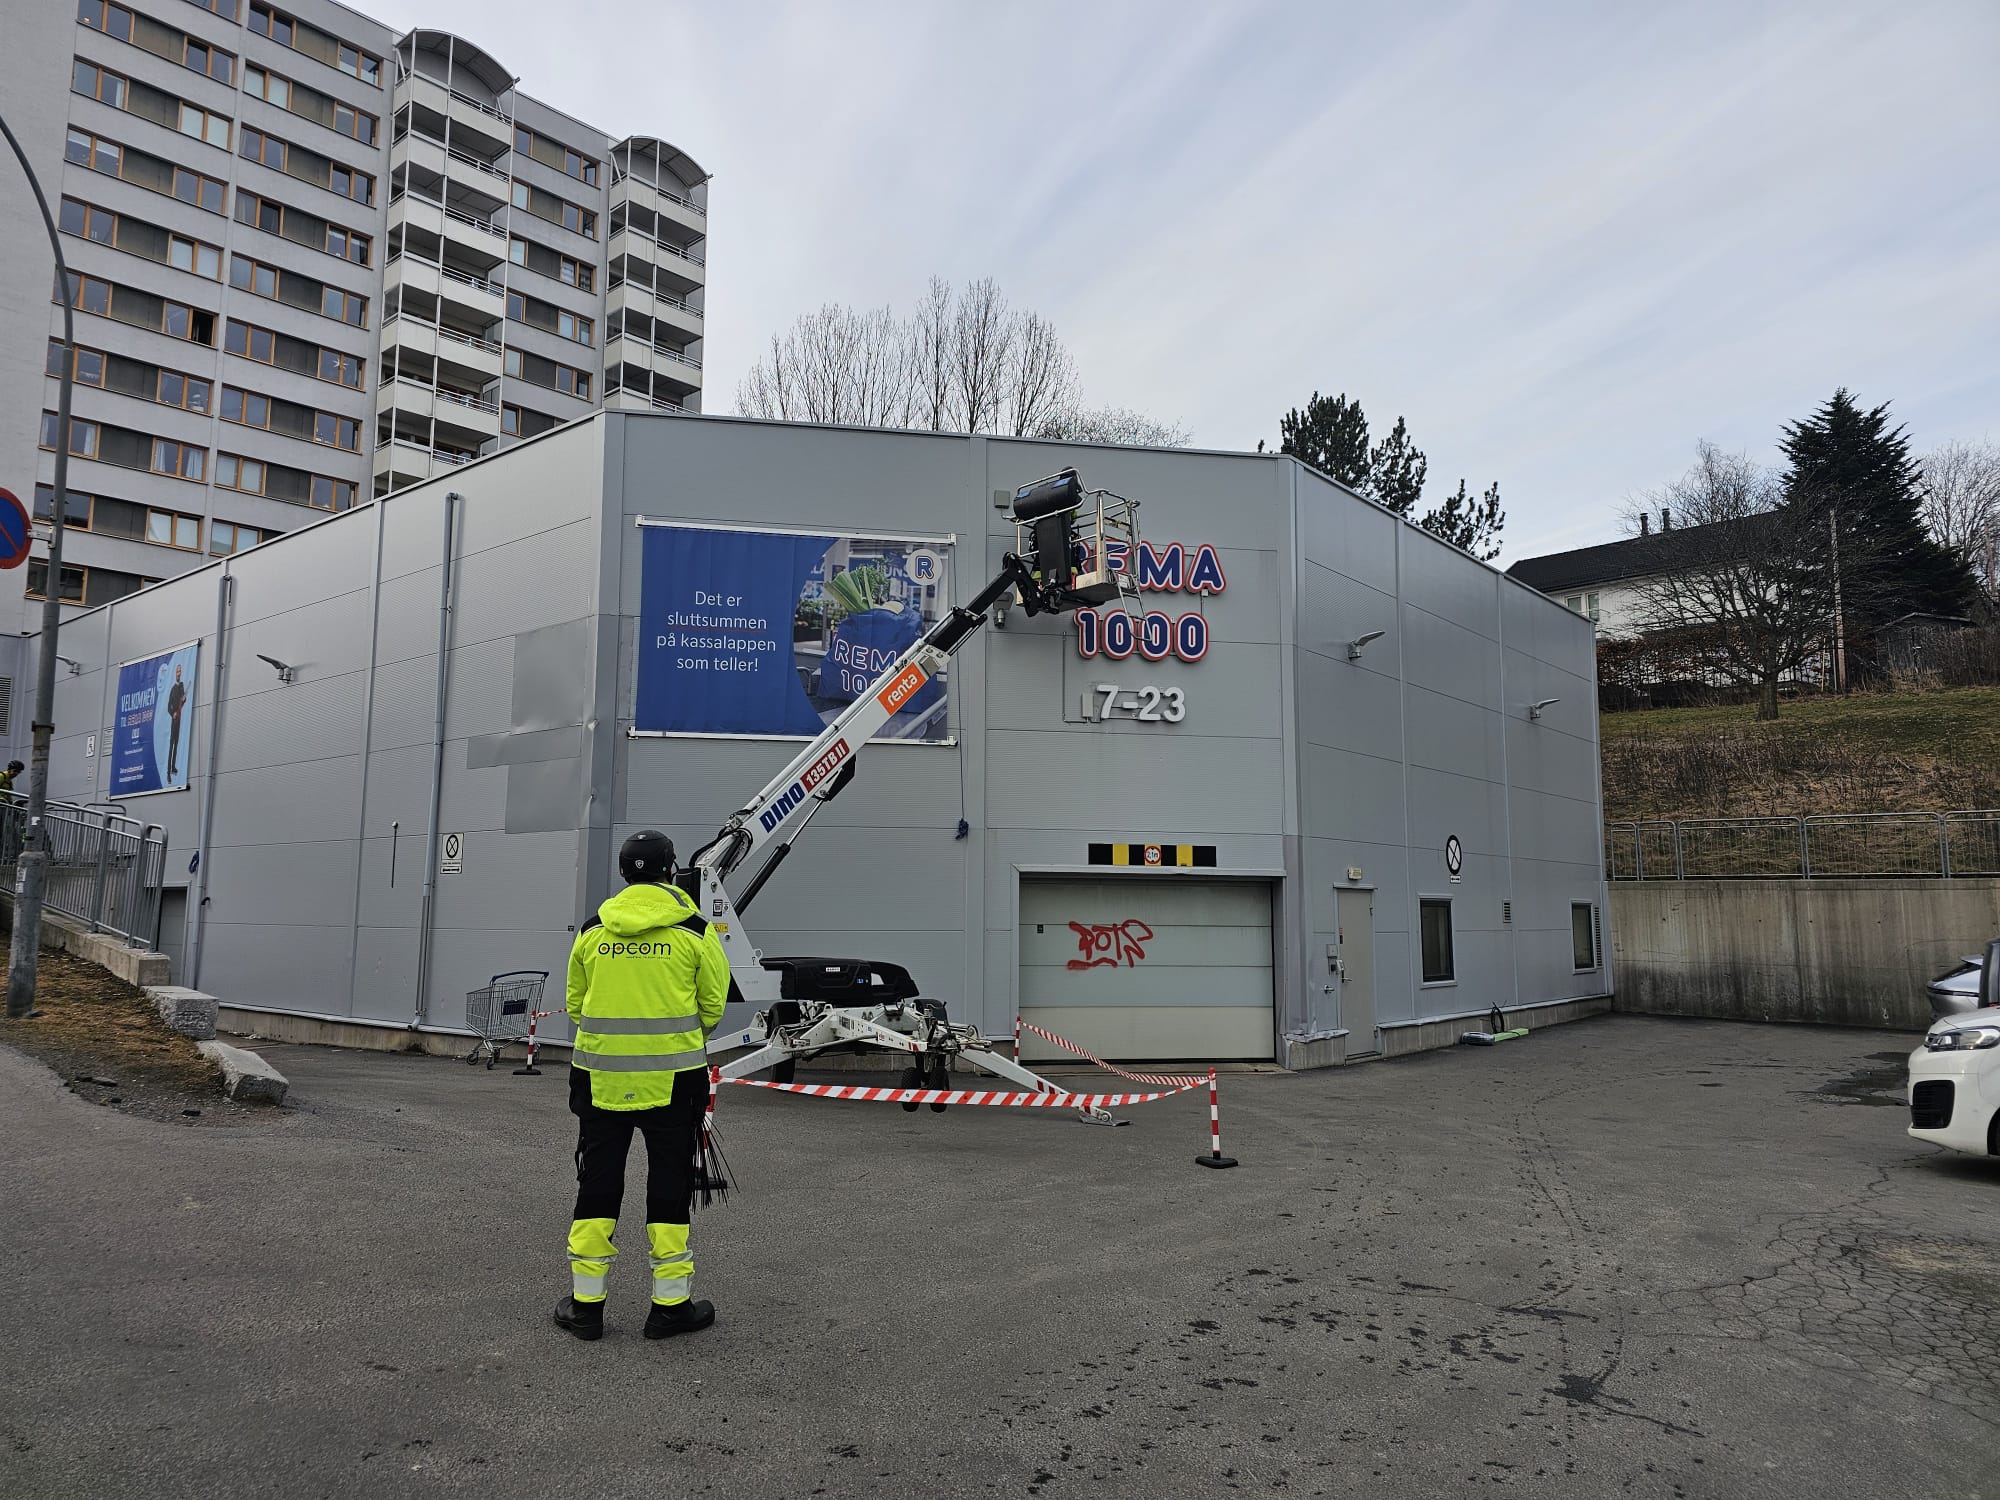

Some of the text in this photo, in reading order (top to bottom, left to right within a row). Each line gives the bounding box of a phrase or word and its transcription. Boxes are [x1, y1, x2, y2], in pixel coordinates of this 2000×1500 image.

[695, 591, 742, 606] Det er
[667, 611, 767, 629] sluttsummen
[657, 632, 776, 652] på kassalappen
[1074, 607, 1209, 662] 1000
[677, 657, 758, 671] som teller!
[886, 673, 918, 706] renta
[1097, 685, 1185, 722] 7-23
[806, 752, 838, 786] 135TB
[759, 782, 806, 833] DINO
[598, 942, 671, 959] opcom
